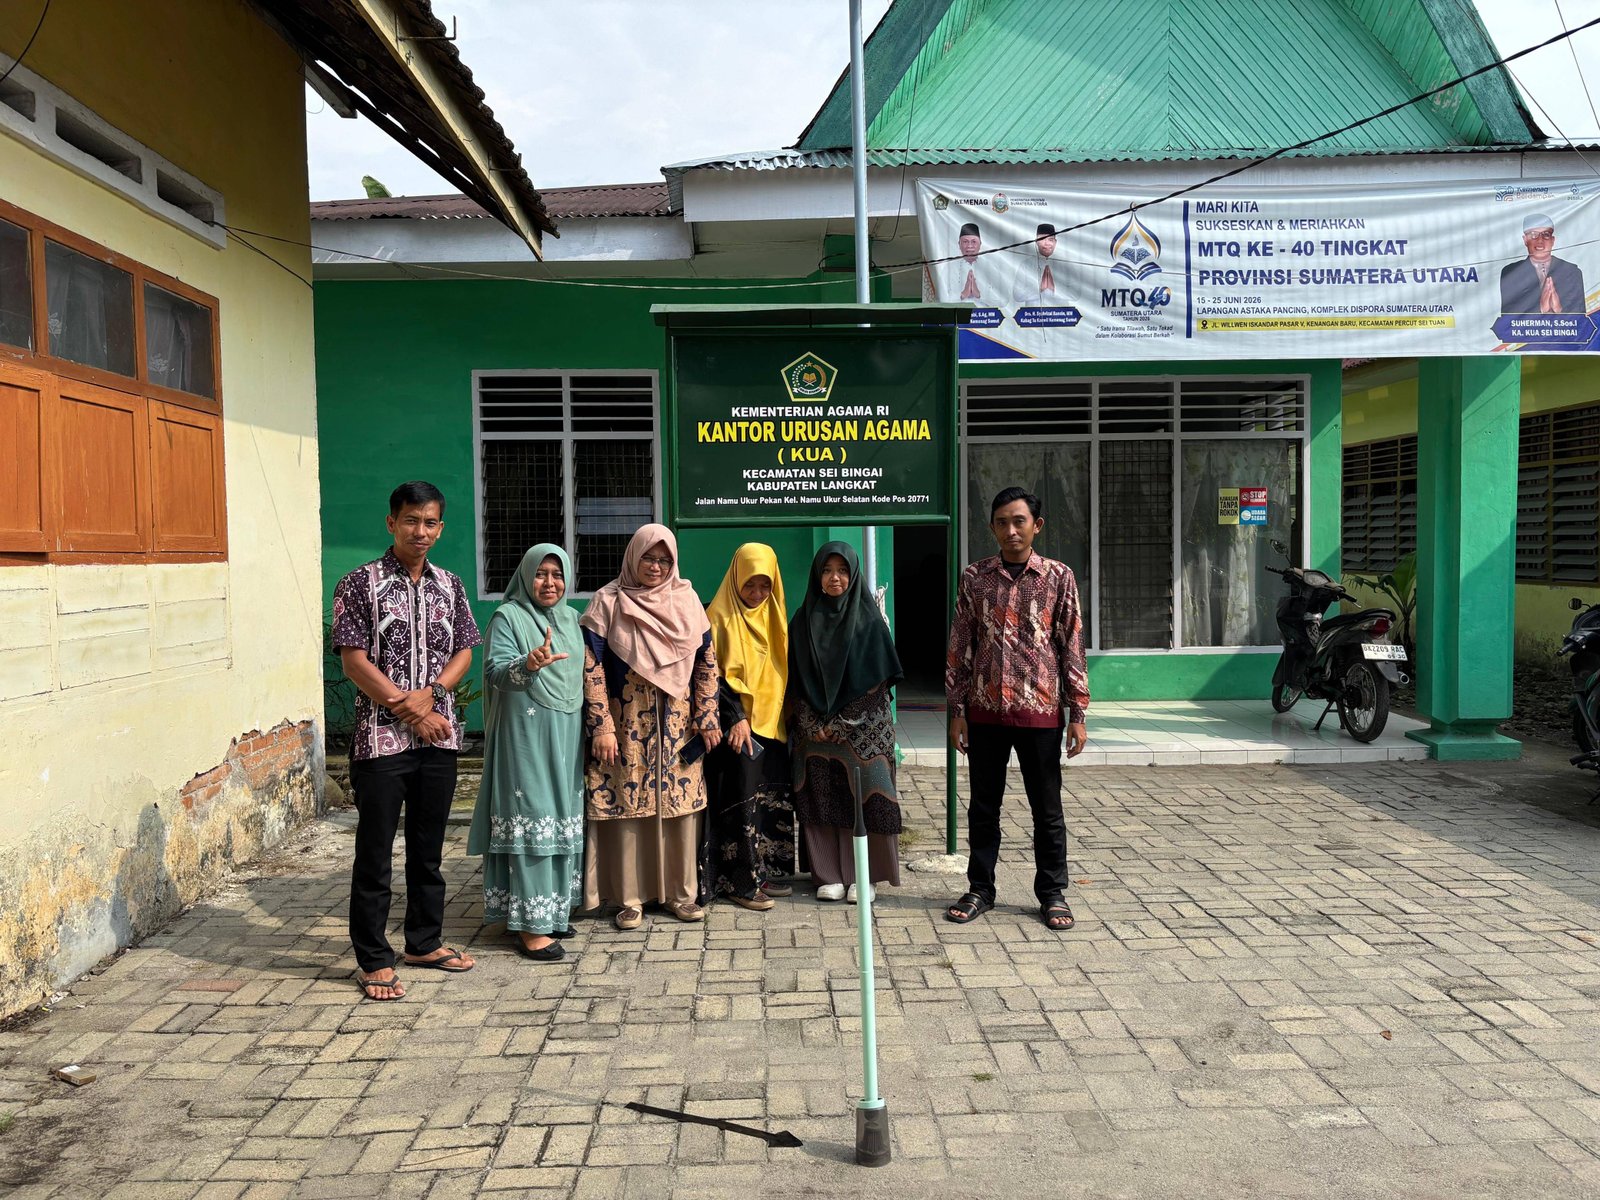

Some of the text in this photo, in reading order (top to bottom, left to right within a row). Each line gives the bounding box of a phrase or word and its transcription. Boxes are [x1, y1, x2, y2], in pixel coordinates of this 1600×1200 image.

[954, 198, 988, 206] KEMENAG
[1196, 201, 1259, 213] MARI KITA
[1196, 218, 1366, 231] SUKSESKAN & MERIAHKAN
[1199, 241, 1240, 258] MTQ
[1248, 241, 1274, 256] KE
[1292, 240, 1315, 256] 40
[1320, 240, 1408, 256] TINGKAT
[1200, 267, 1479, 286] PROVINSI SUMATERA UTARA
[1101, 288, 1148, 308] MTQ
[1197, 296, 1206, 304] 15
[1212, 296, 1222, 304] 25
[1224, 296, 1242, 304] JUNI
[1244, 296, 1262, 304] 2026
[1240, 306, 1270, 314] ASTAKA
[1272, 306, 1310, 314] PANCING,
[1311, 306, 1348, 314] KOMPLEK
[1350, 305, 1385, 313] DISPORA
[1386, 304, 1428, 313] SUMATERA
[1428, 304, 1454, 312] UTARA
[732, 405, 889, 418] KEMENTERIAN AGAMA RI
[697, 420, 931, 442] KANTOR URUSAN AGAMA
[742, 468, 883, 479] KECAMATAN SEI BINGAI
[747, 480, 877, 491] KABUPATEN LANGKAT
[695, 497, 716, 505] Jalan
[717, 497, 739, 505] Namu
[760, 496, 782, 504] Pekan
[784, 496, 798, 504] Kel.
[800, 496, 822, 504] Namu
[823, 496, 841, 504] Ukur
[872, 495, 890, 503] Kode
[892, 495, 906, 503] Pos
[1220, 501, 1238, 509] TANPA
[1220, 509, 1238, 517] ROKOK
